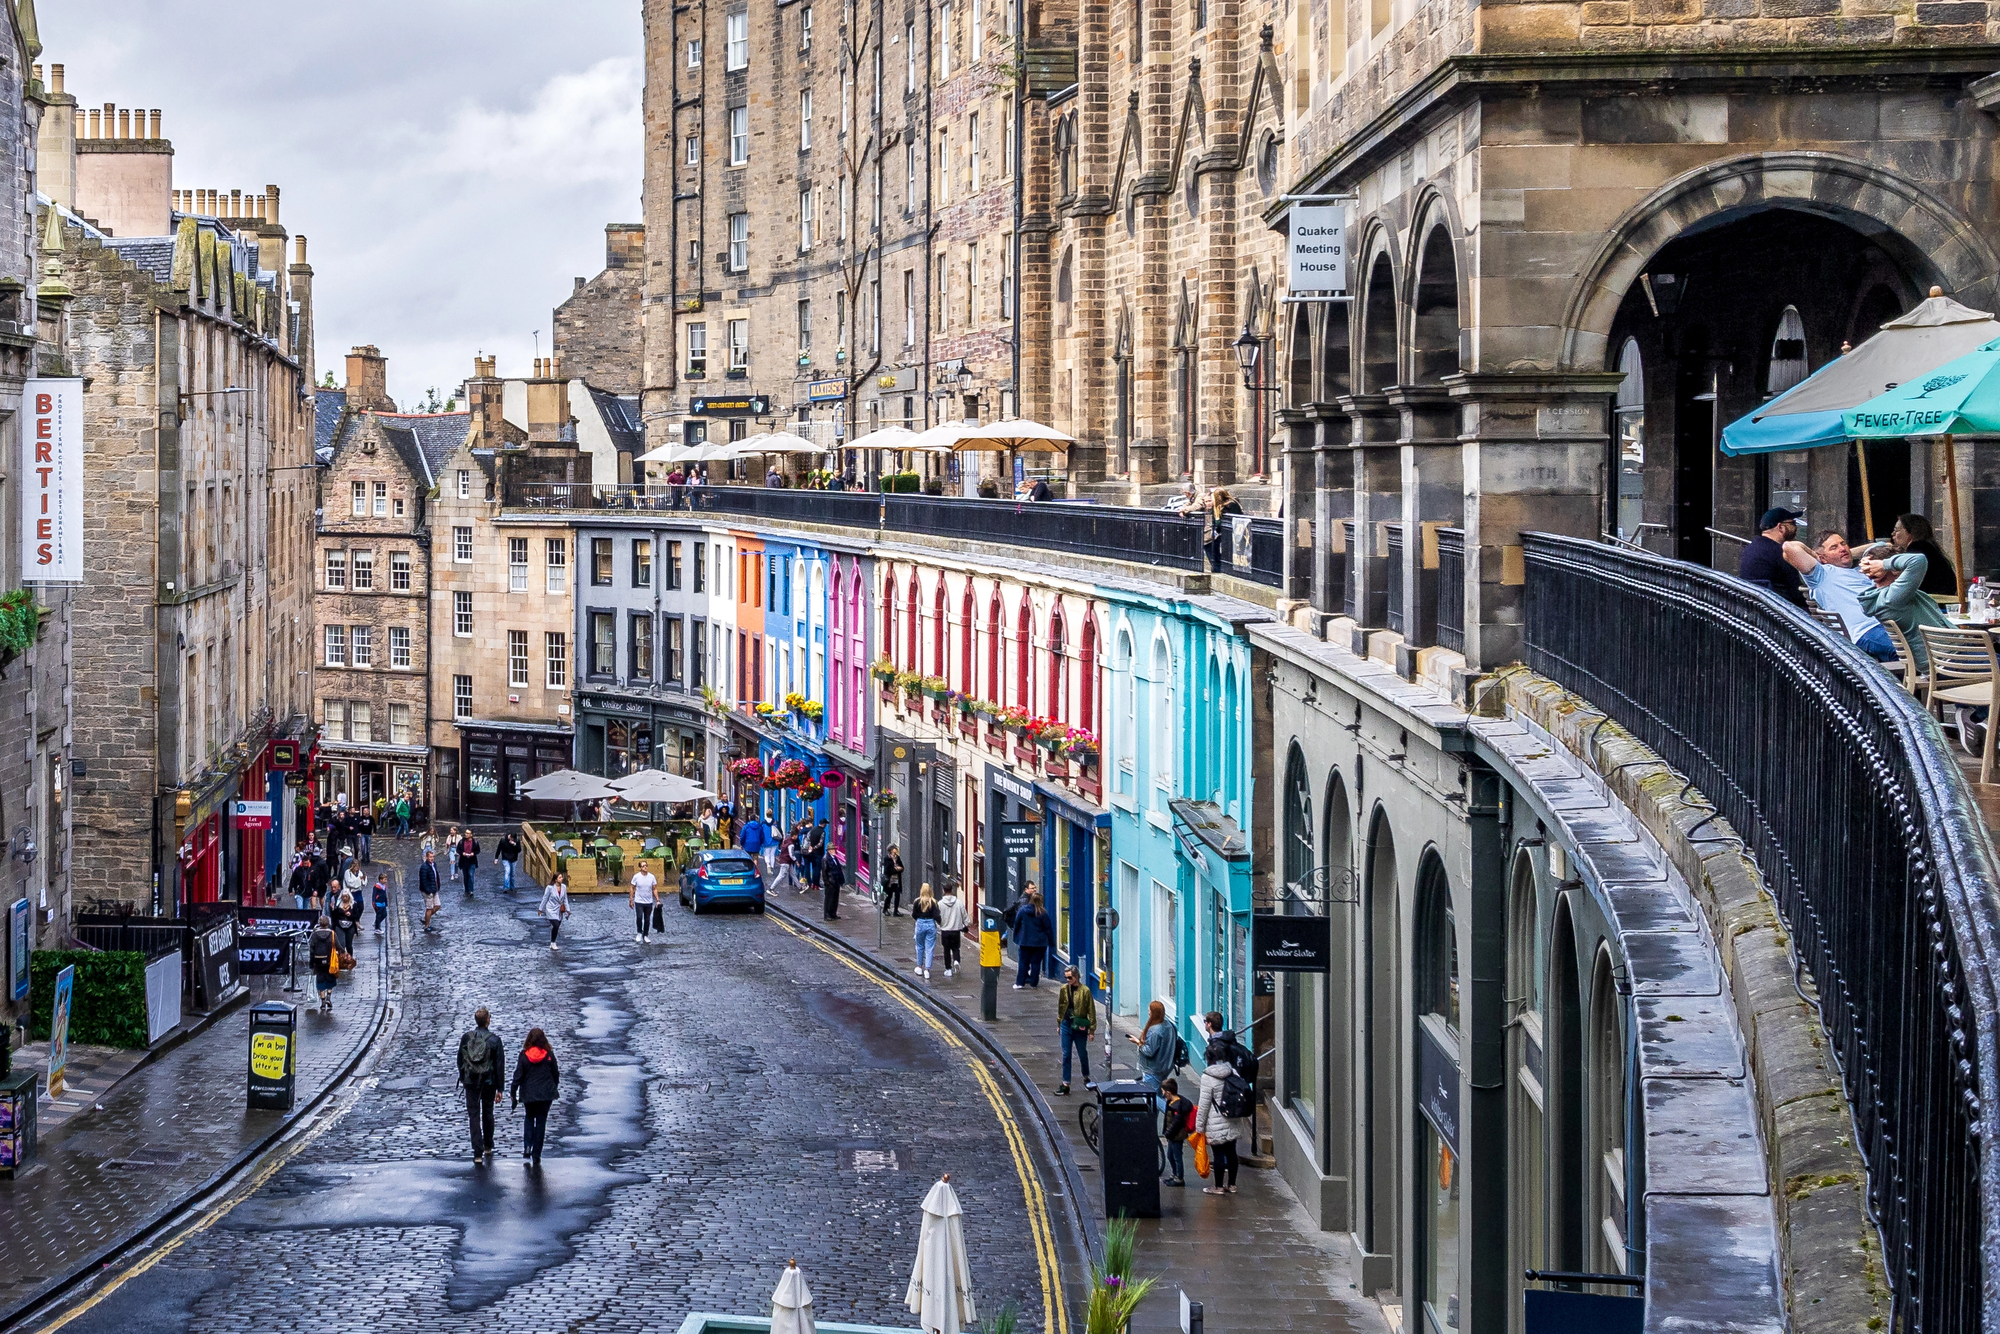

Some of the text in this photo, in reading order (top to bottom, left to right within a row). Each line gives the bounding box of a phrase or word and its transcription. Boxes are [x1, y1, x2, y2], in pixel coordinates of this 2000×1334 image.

[1298, 227, 1339, 236] Quaker
[1296, 244, 1341, 255] Meeting
[1300, 262, 1336, 271] House
[1853, 410, 1943, 428] FEVER-TREE
[35, 393, 53, 566] BERTIES
[601, 700, 624, 710] Walker
[626, 702, 645, 712] Slater
[1266, 949, 1316, 957] Walker Slater
[253, 1037, 264, 1049] I'm
[276, 1041, 285, 1050] bin
[253, 1052, 284, 1063] Drop your
[255, 1062, 271, 1070] litter
